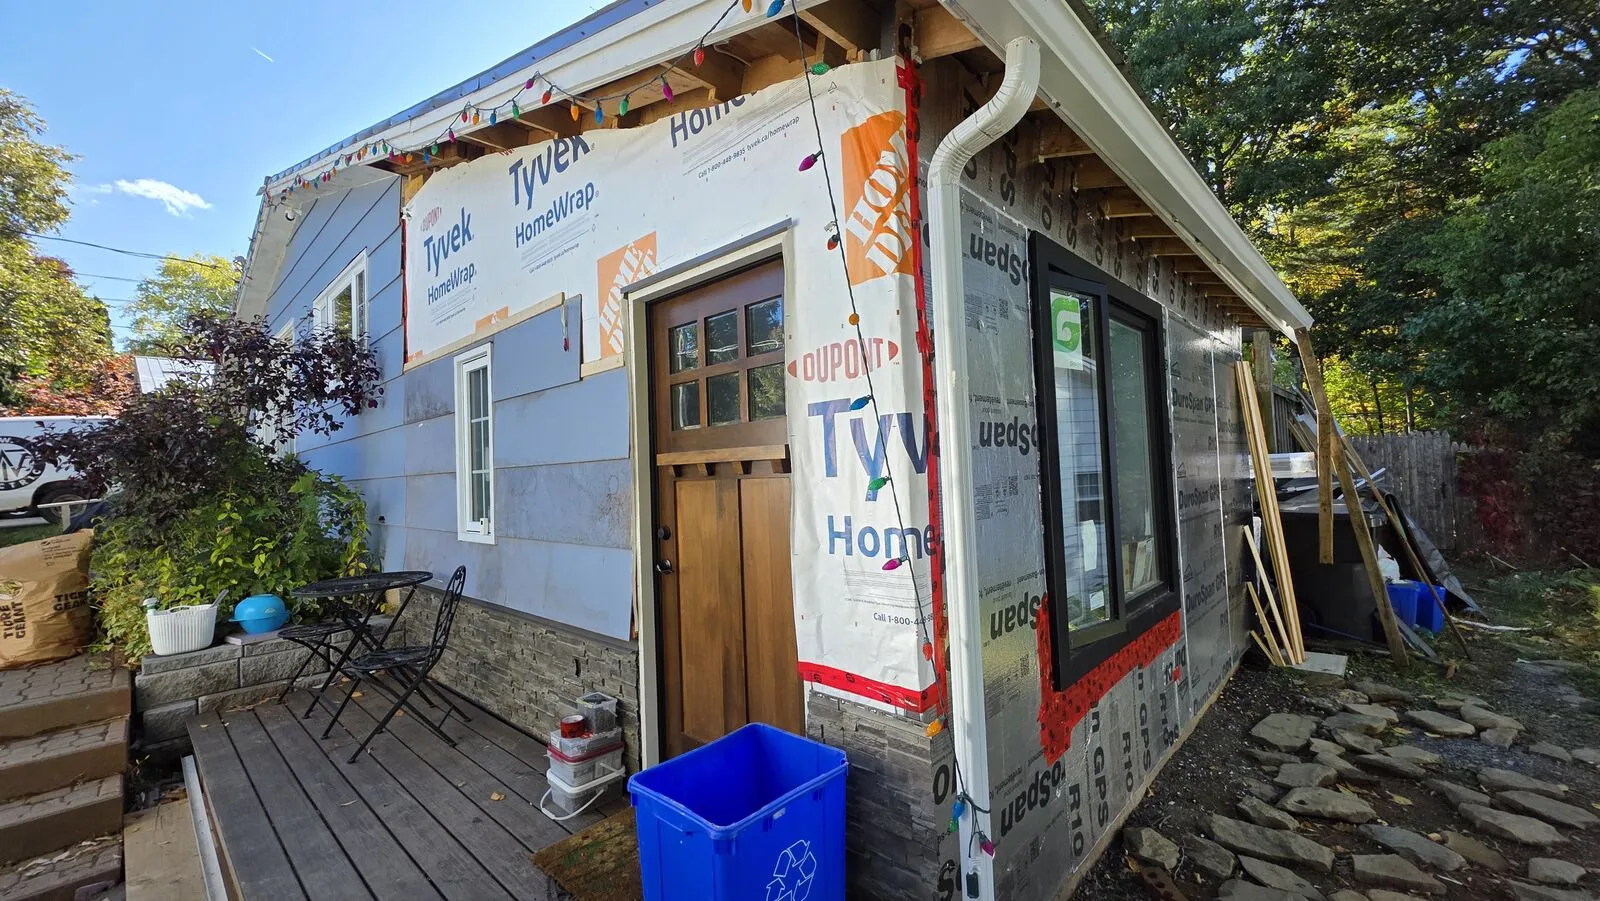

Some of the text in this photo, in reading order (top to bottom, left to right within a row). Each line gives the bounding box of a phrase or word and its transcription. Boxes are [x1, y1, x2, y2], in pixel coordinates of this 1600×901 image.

[515, 182, 595, 248] HomeWrap
[845, 130, 909, 246] HOM
[424, 206, 472, 277] Tyvek
[427, 263, 475, 305] HomeWrap
[802, 338, 884, 384] DUPONT
[808, 397, 929, 502] Tyv
[828, 515, 937, 560] Home
[11, 601, 26, 639] GEANT
[873, 612, 886, 622] Call
[1122, 731, 1134, 793] R10
[1139, 702, 1152, 771] GPS
[1068, 783, 1084, 857] R10
[1093, 747, 1109, 828] GPS
